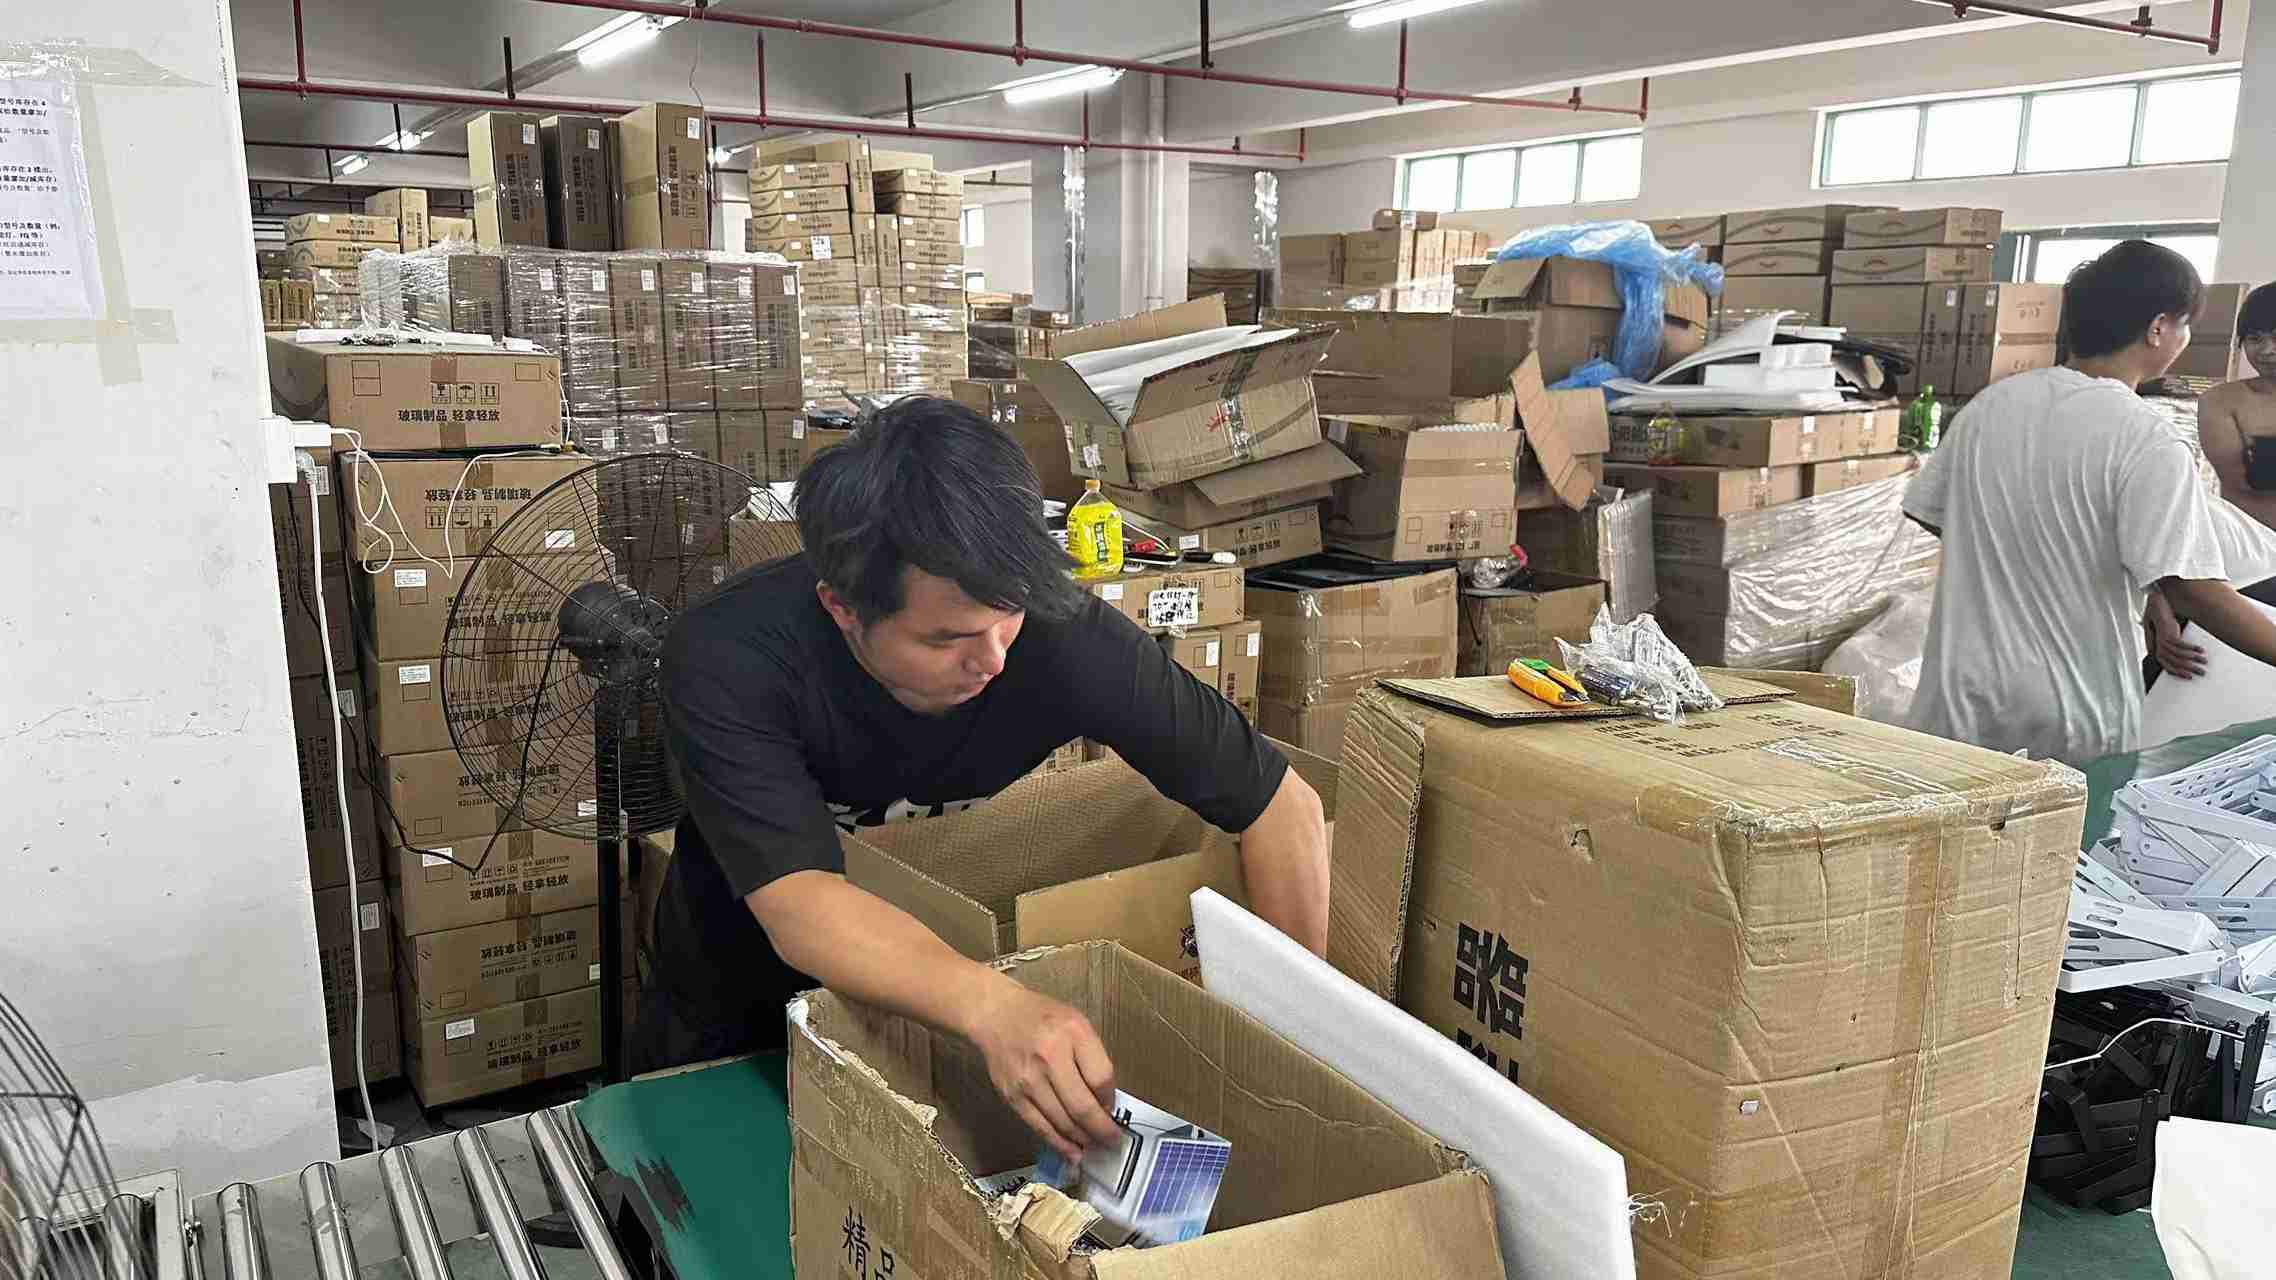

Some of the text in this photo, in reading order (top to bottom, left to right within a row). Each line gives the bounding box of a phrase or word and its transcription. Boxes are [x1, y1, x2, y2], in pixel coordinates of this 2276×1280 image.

[398, 408, 500, 422] 玻璃制品 轻拿轻放
[469, 882, 518, 900] 玻璃制品
